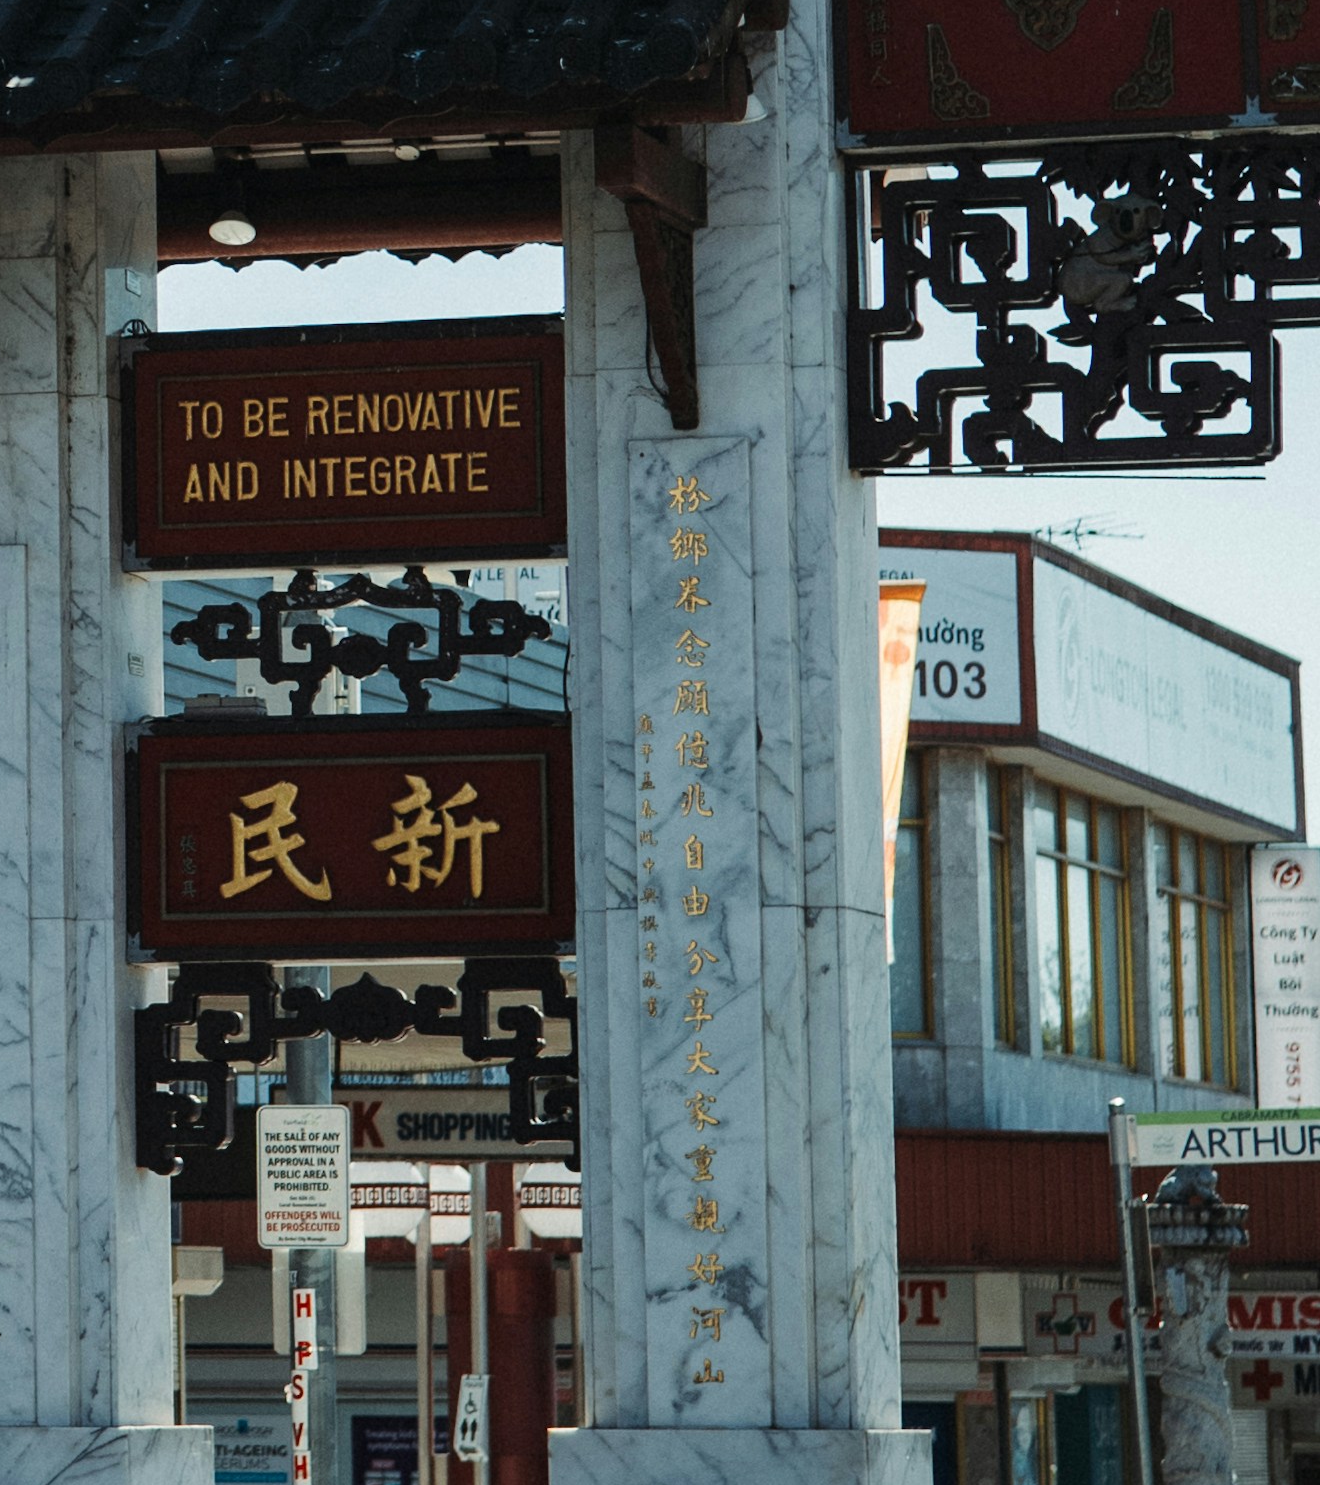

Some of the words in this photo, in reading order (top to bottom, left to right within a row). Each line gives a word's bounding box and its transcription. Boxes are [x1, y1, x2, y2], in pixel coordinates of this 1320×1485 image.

[179, 400, 224, 441] TO
[242, 395, 290, 438] BE
[307, 387, 522, 436] RENOVATIVE
[183, 460, 259, 504] AND
[283, 451, 490, 501] INTEGRATE
[1260, 925, 1296, 940] Công
[1221, 1109, 1300, 1122] CABRAMATTA
[397, 1112, 511, 1141] SHOPPING
[265, 1132, 281, 1141] THE
[284, 1132, 306, 1141] SALE
[309, 1132, 320, 1141] OF
[322, 1132, 340, 1141] ANY
[265, 1145, 297, 1154] GOODS
[299, 1145, 340, 1153] WITHOUT
[268, 1158, 314, 1166] APPROVAL
[317, 1158, 326, 1166] IN
[329, 1158, 335, 1166] A
[267, 1170, 301, 1179] PUBLIC
[303, 1170, 327, 1179] AREA
[329, 1170, 338, 1179] IS
[274, 1182, 331, 1191] PROHIBITED.
[265, 1211, 318, 1220] OFFENDERS
[320, 1211, 342, 1220] WILL
[266, 1223, 278, 1231] BE
[281, 1223, 340, 1231] PROSECUTED
[1294, 1362, 1320, 1395] M
